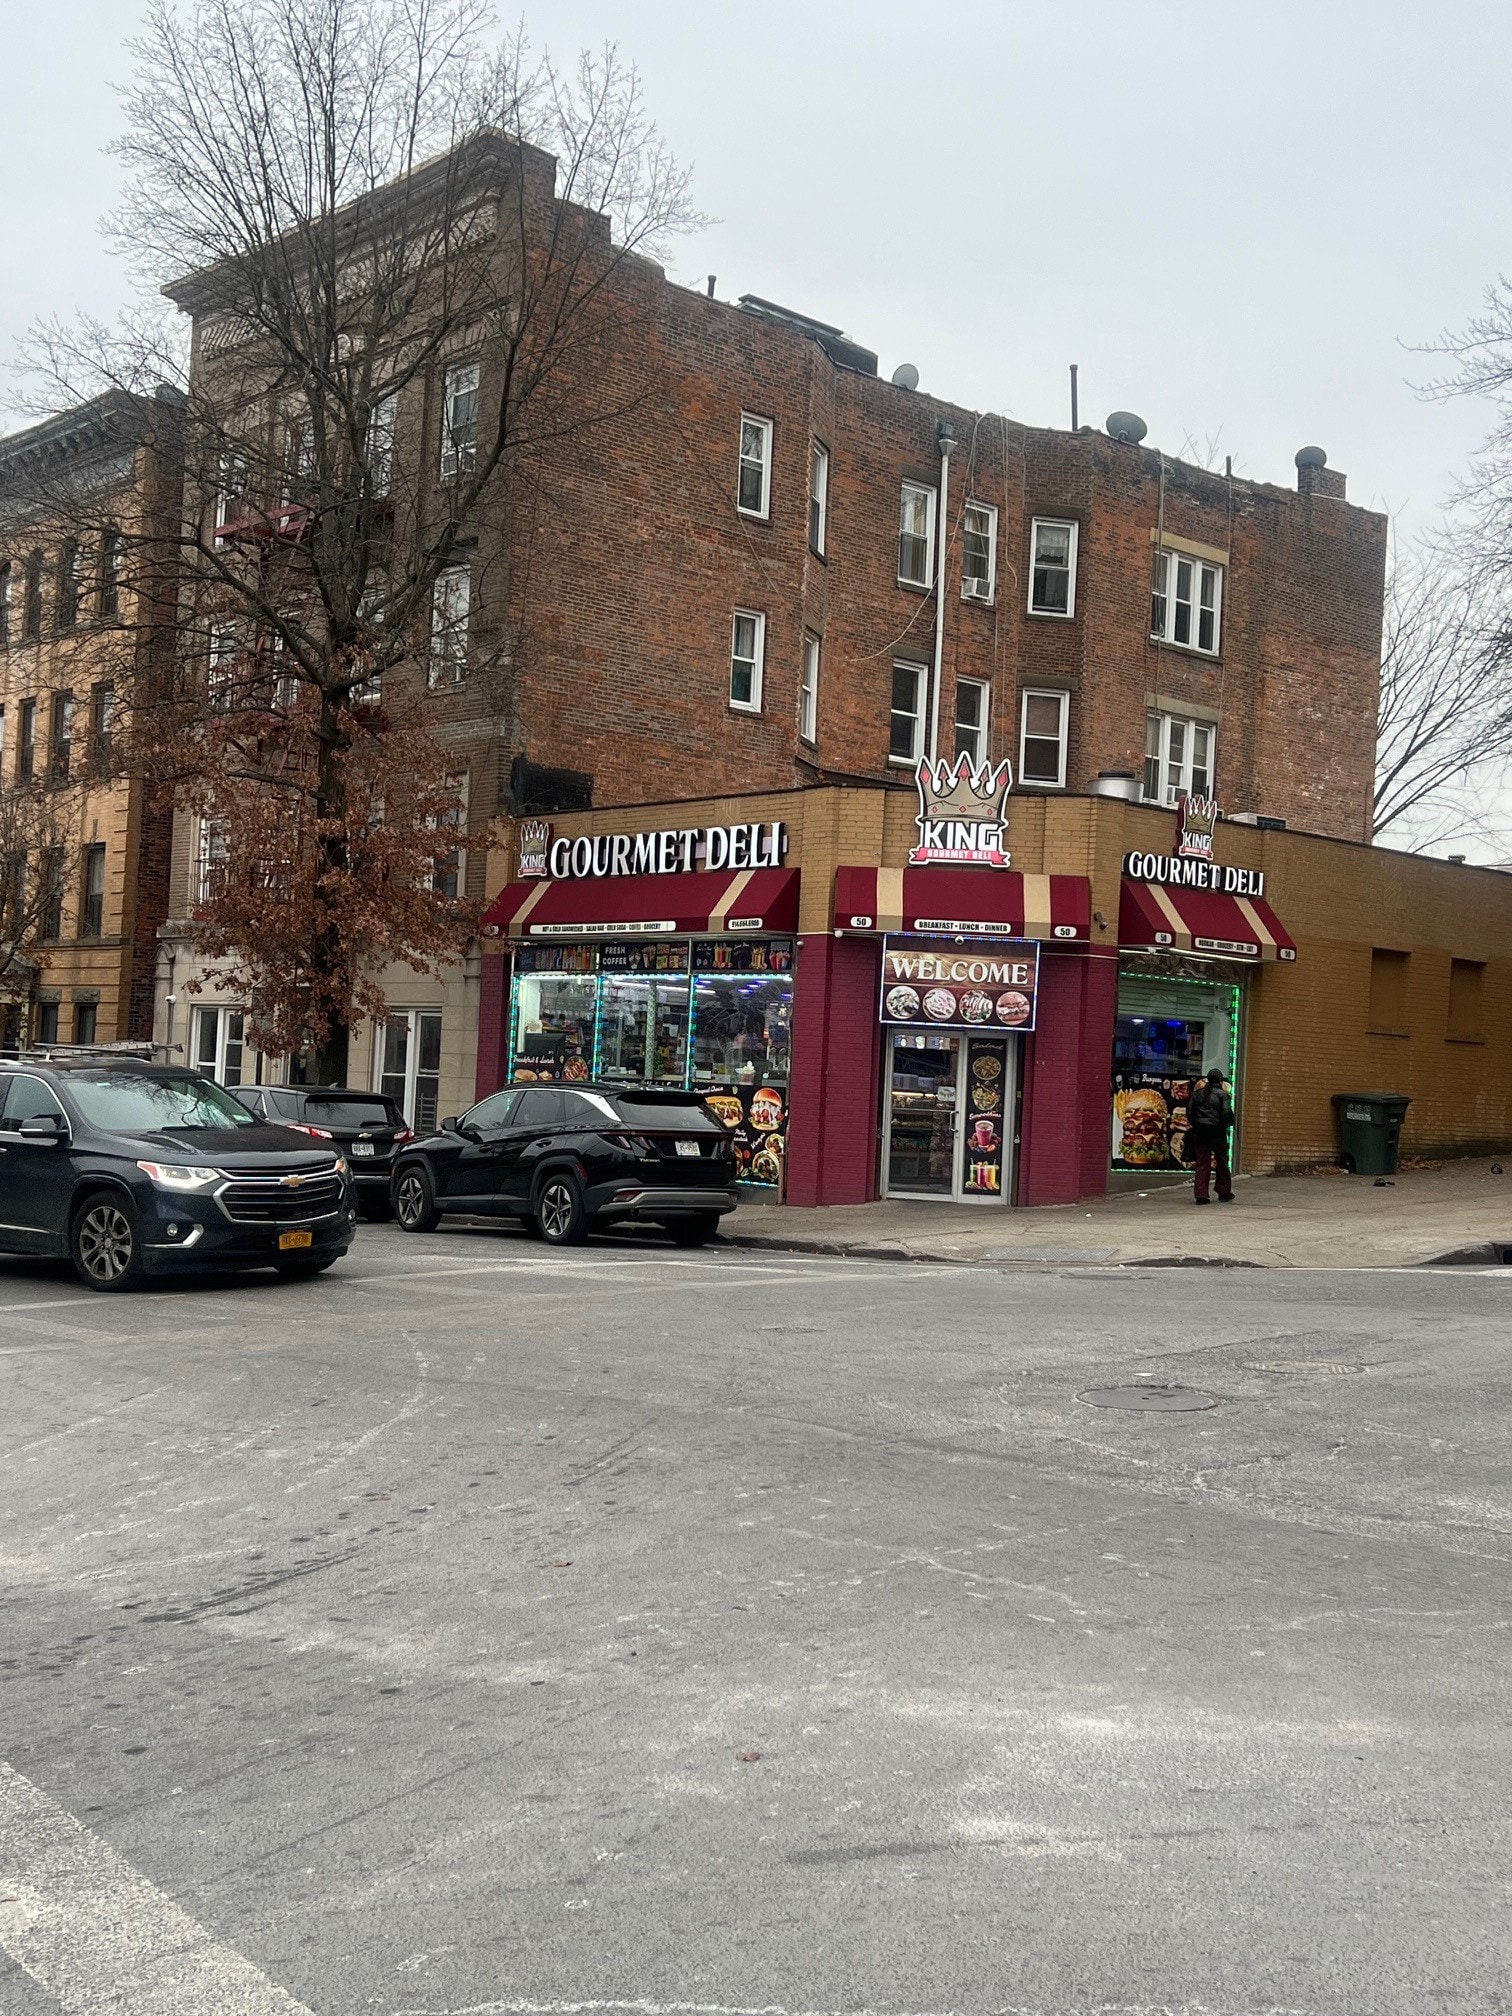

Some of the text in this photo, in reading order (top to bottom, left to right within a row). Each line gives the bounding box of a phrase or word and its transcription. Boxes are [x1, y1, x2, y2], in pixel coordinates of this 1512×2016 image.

[924, 821, 1001, 852] KING
[1183, 832, 1211, 850] KING
[550, 822, 784, 879] GOURMET DELI
[927, 849, 993, 860] GOURMET DELI
[522, 854, 545, 868] KING
[1128, 851, 1264, 896] GOURMET DELI
[856, 917, 867, 927] 50
[918, 921, 1008, 933] BREAKFAST LUNCH DINNER
[1060, 927, 1071, 937] 50
[1160, 934, 1167, 942] 50
[605, 947, 626, 955] FRESH
[602, 957, 627, 965] COFFEE
[890, 956, 1028, 985] WELCOME
